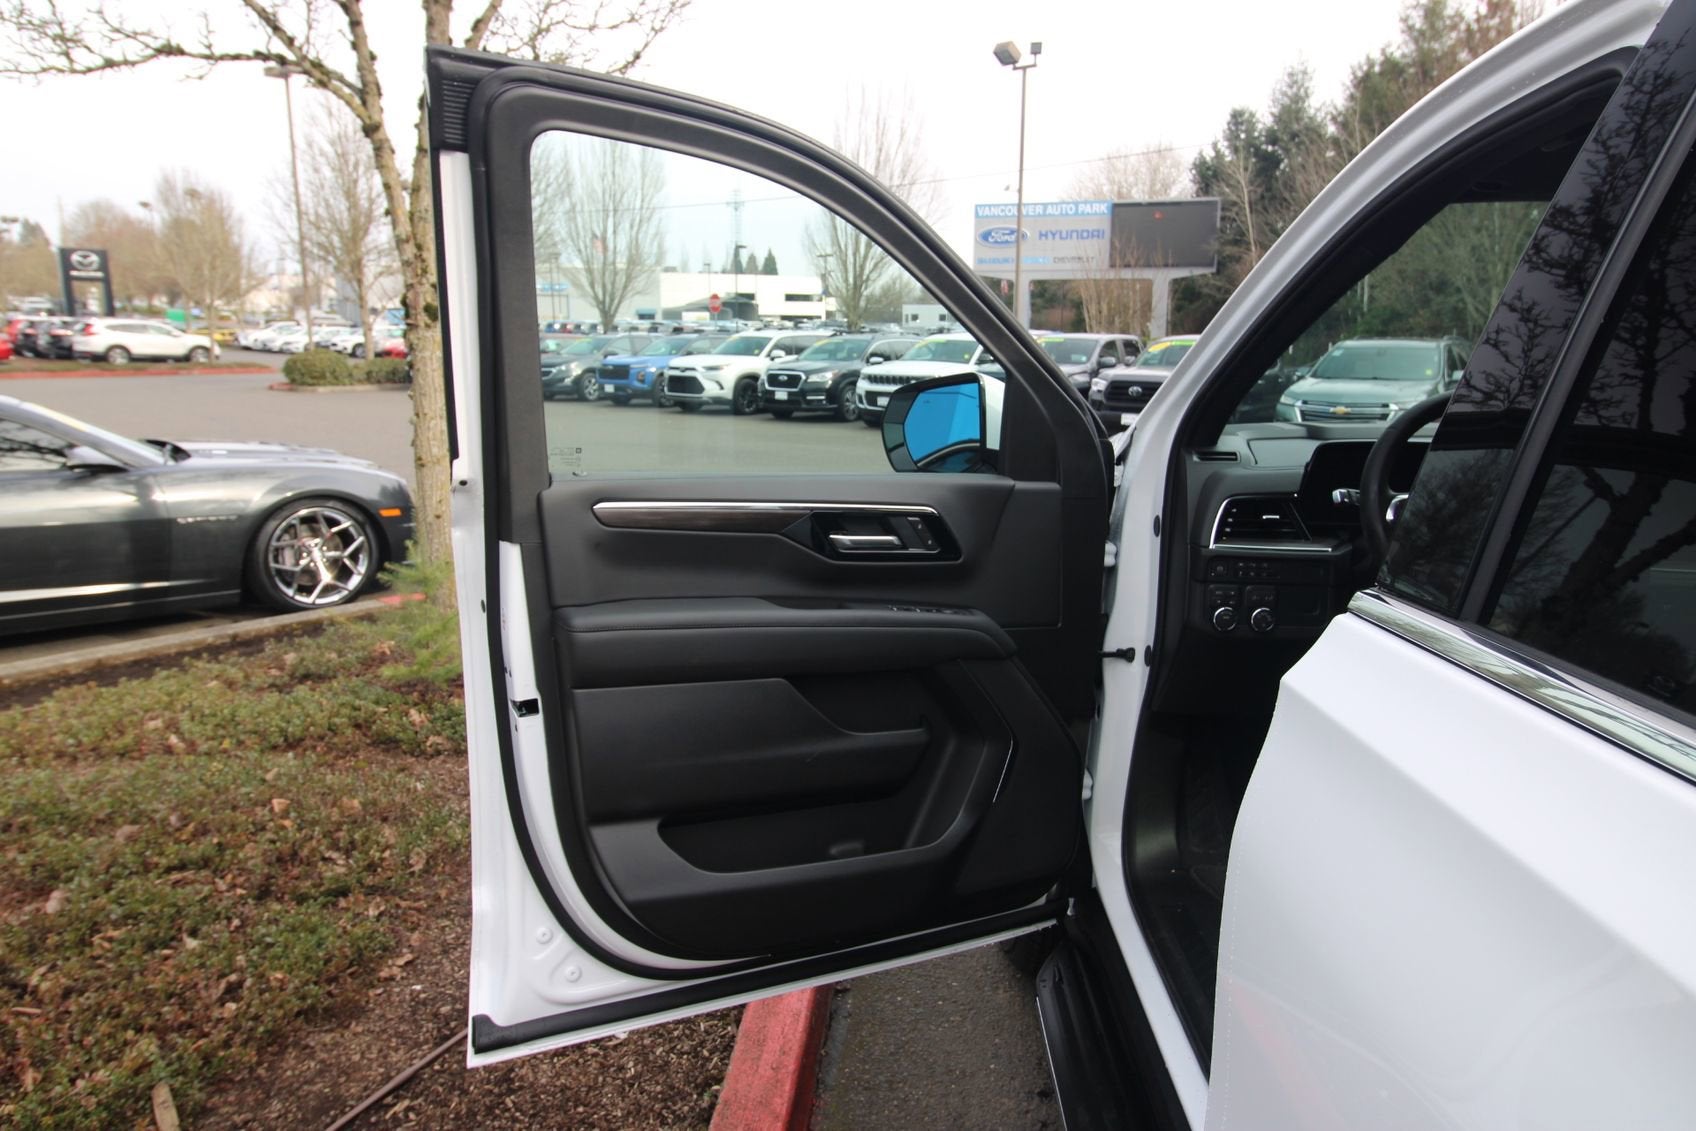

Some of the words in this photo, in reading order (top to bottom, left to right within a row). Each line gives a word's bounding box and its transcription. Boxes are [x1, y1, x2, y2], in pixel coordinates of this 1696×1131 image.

[1046, 203, 1075, 215] AUTO
[1078, 202, 1108, 214] PARK
[988, 228, 1017, 242] Ford
[1039, 229, 1105, 241] HYUNDAI
